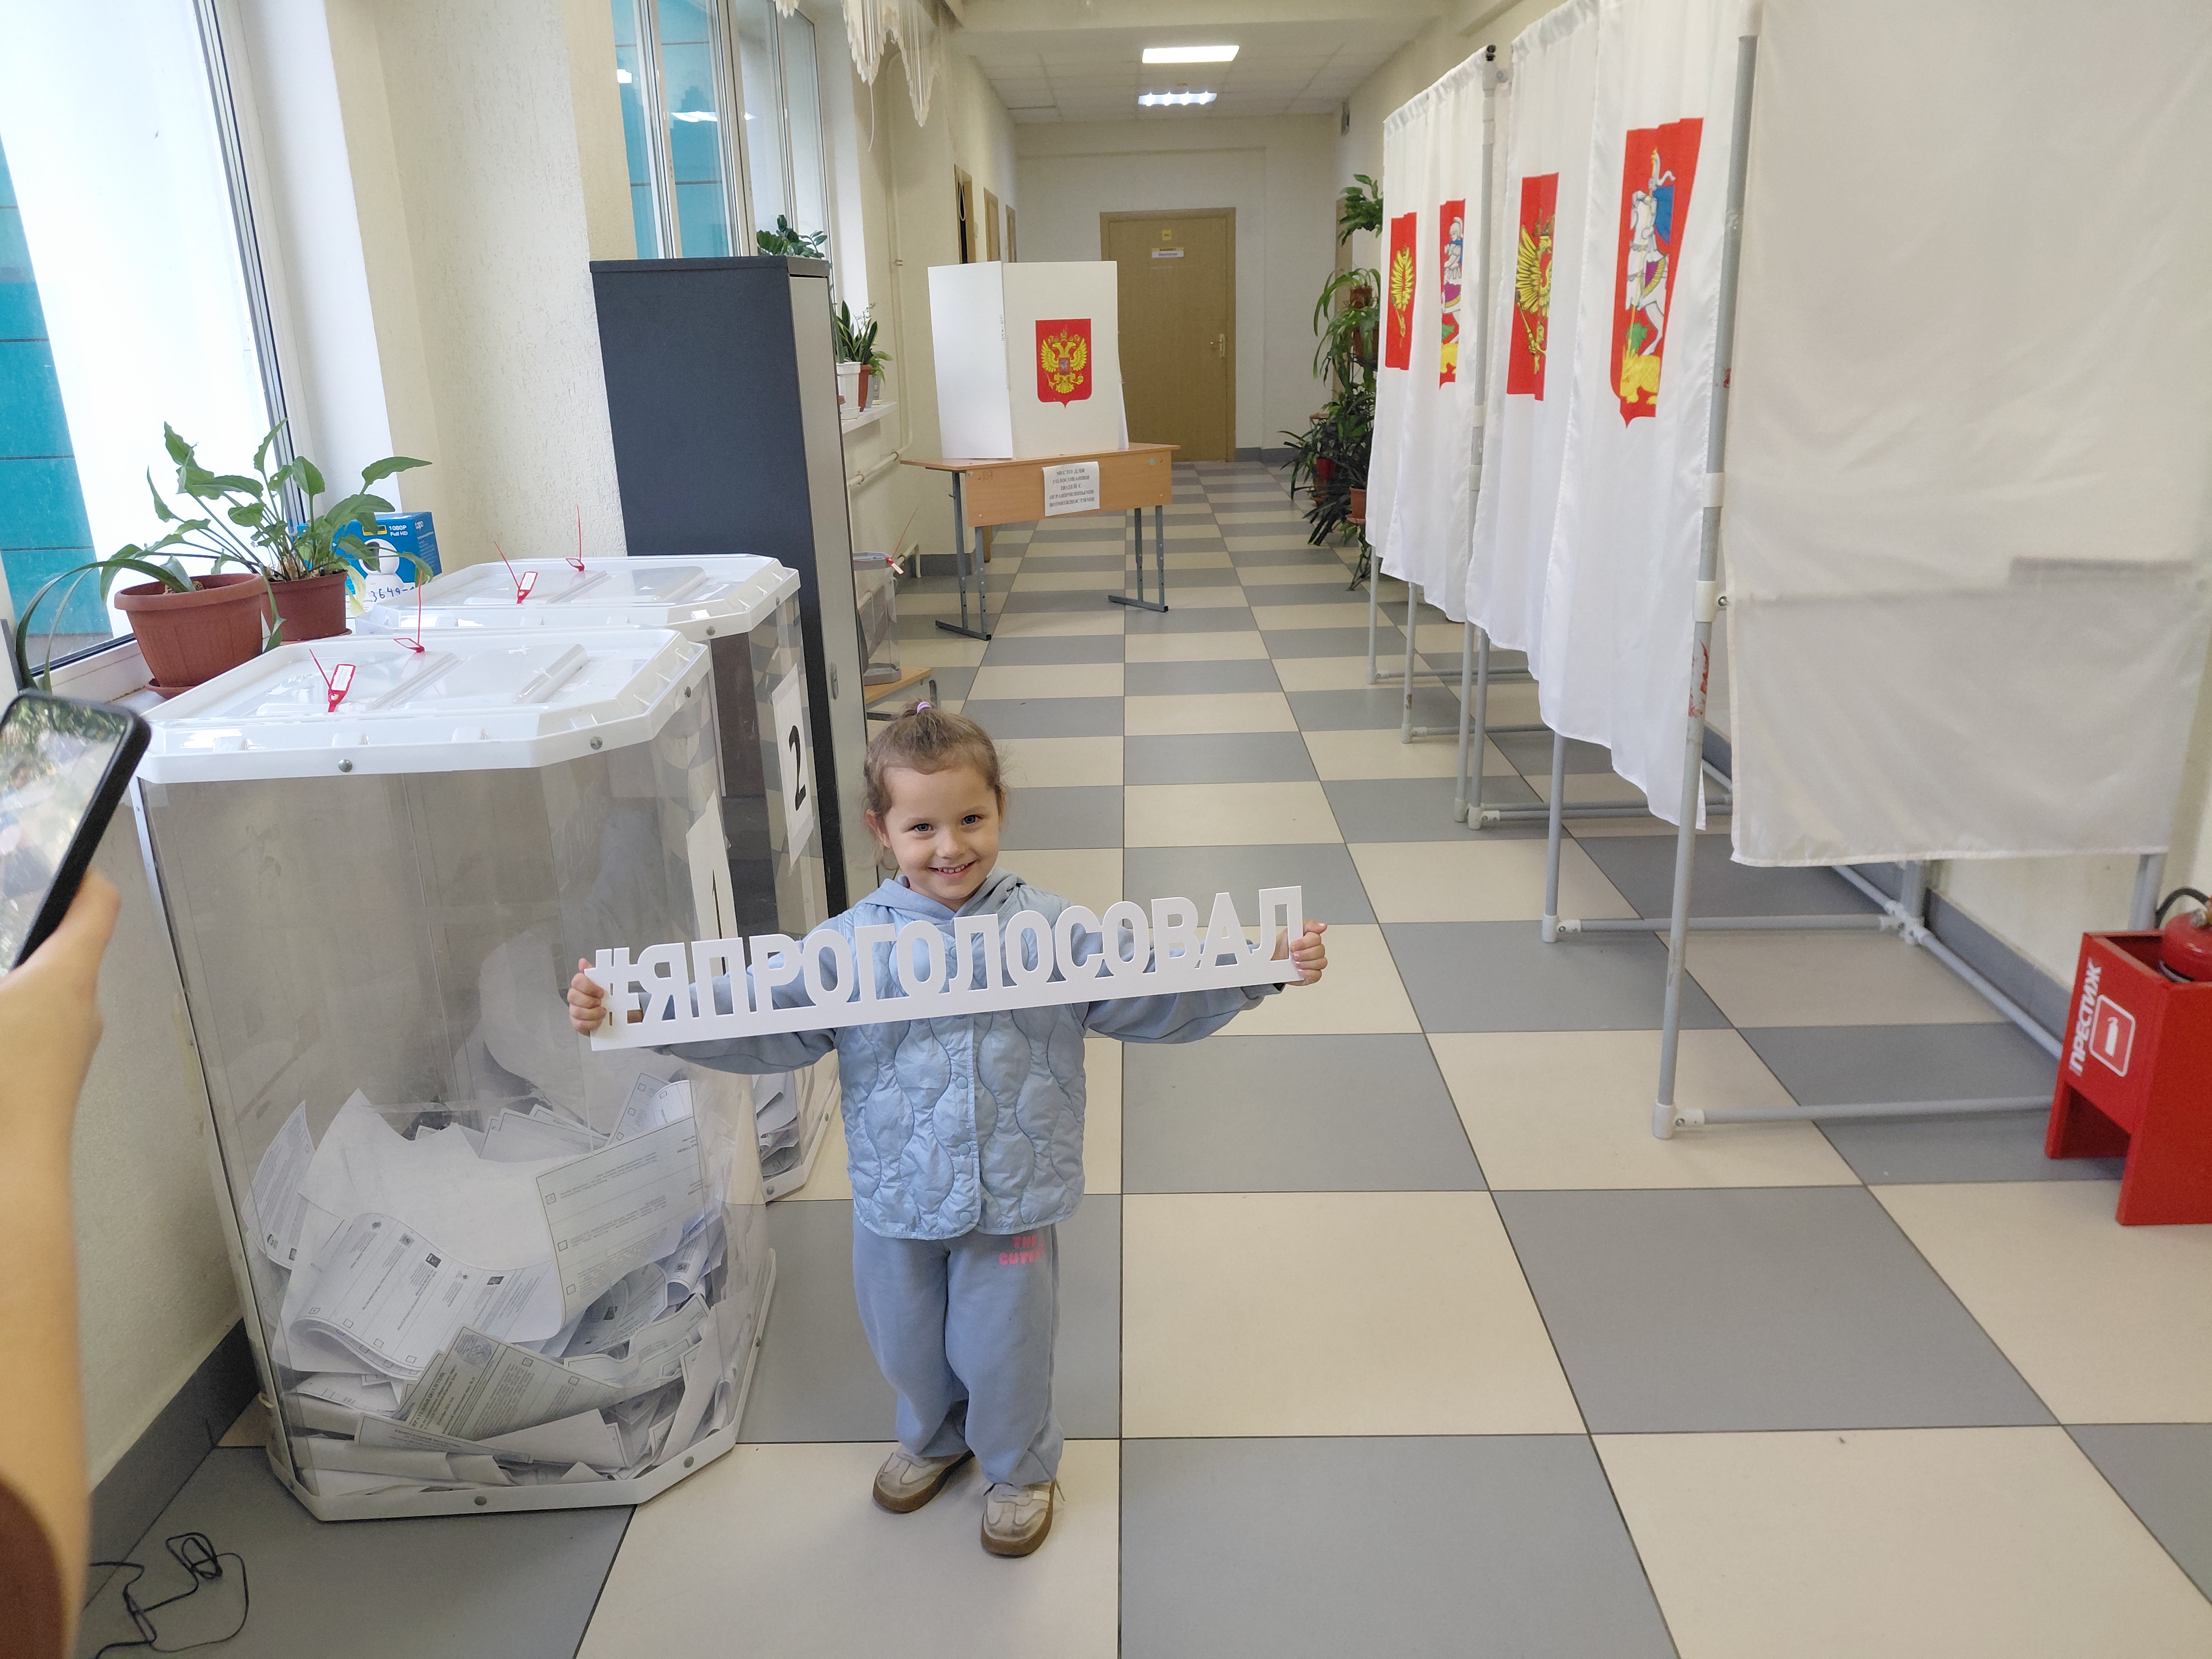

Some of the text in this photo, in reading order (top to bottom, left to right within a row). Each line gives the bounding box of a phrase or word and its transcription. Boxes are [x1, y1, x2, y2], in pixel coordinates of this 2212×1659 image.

[789, 725, 806, 811] 2
[584, 885, 1302, 1027] #ЯПРОГОЛОСОВАЛ
[2068, 957, 2101, 1076] ПРЕСТИЖ
